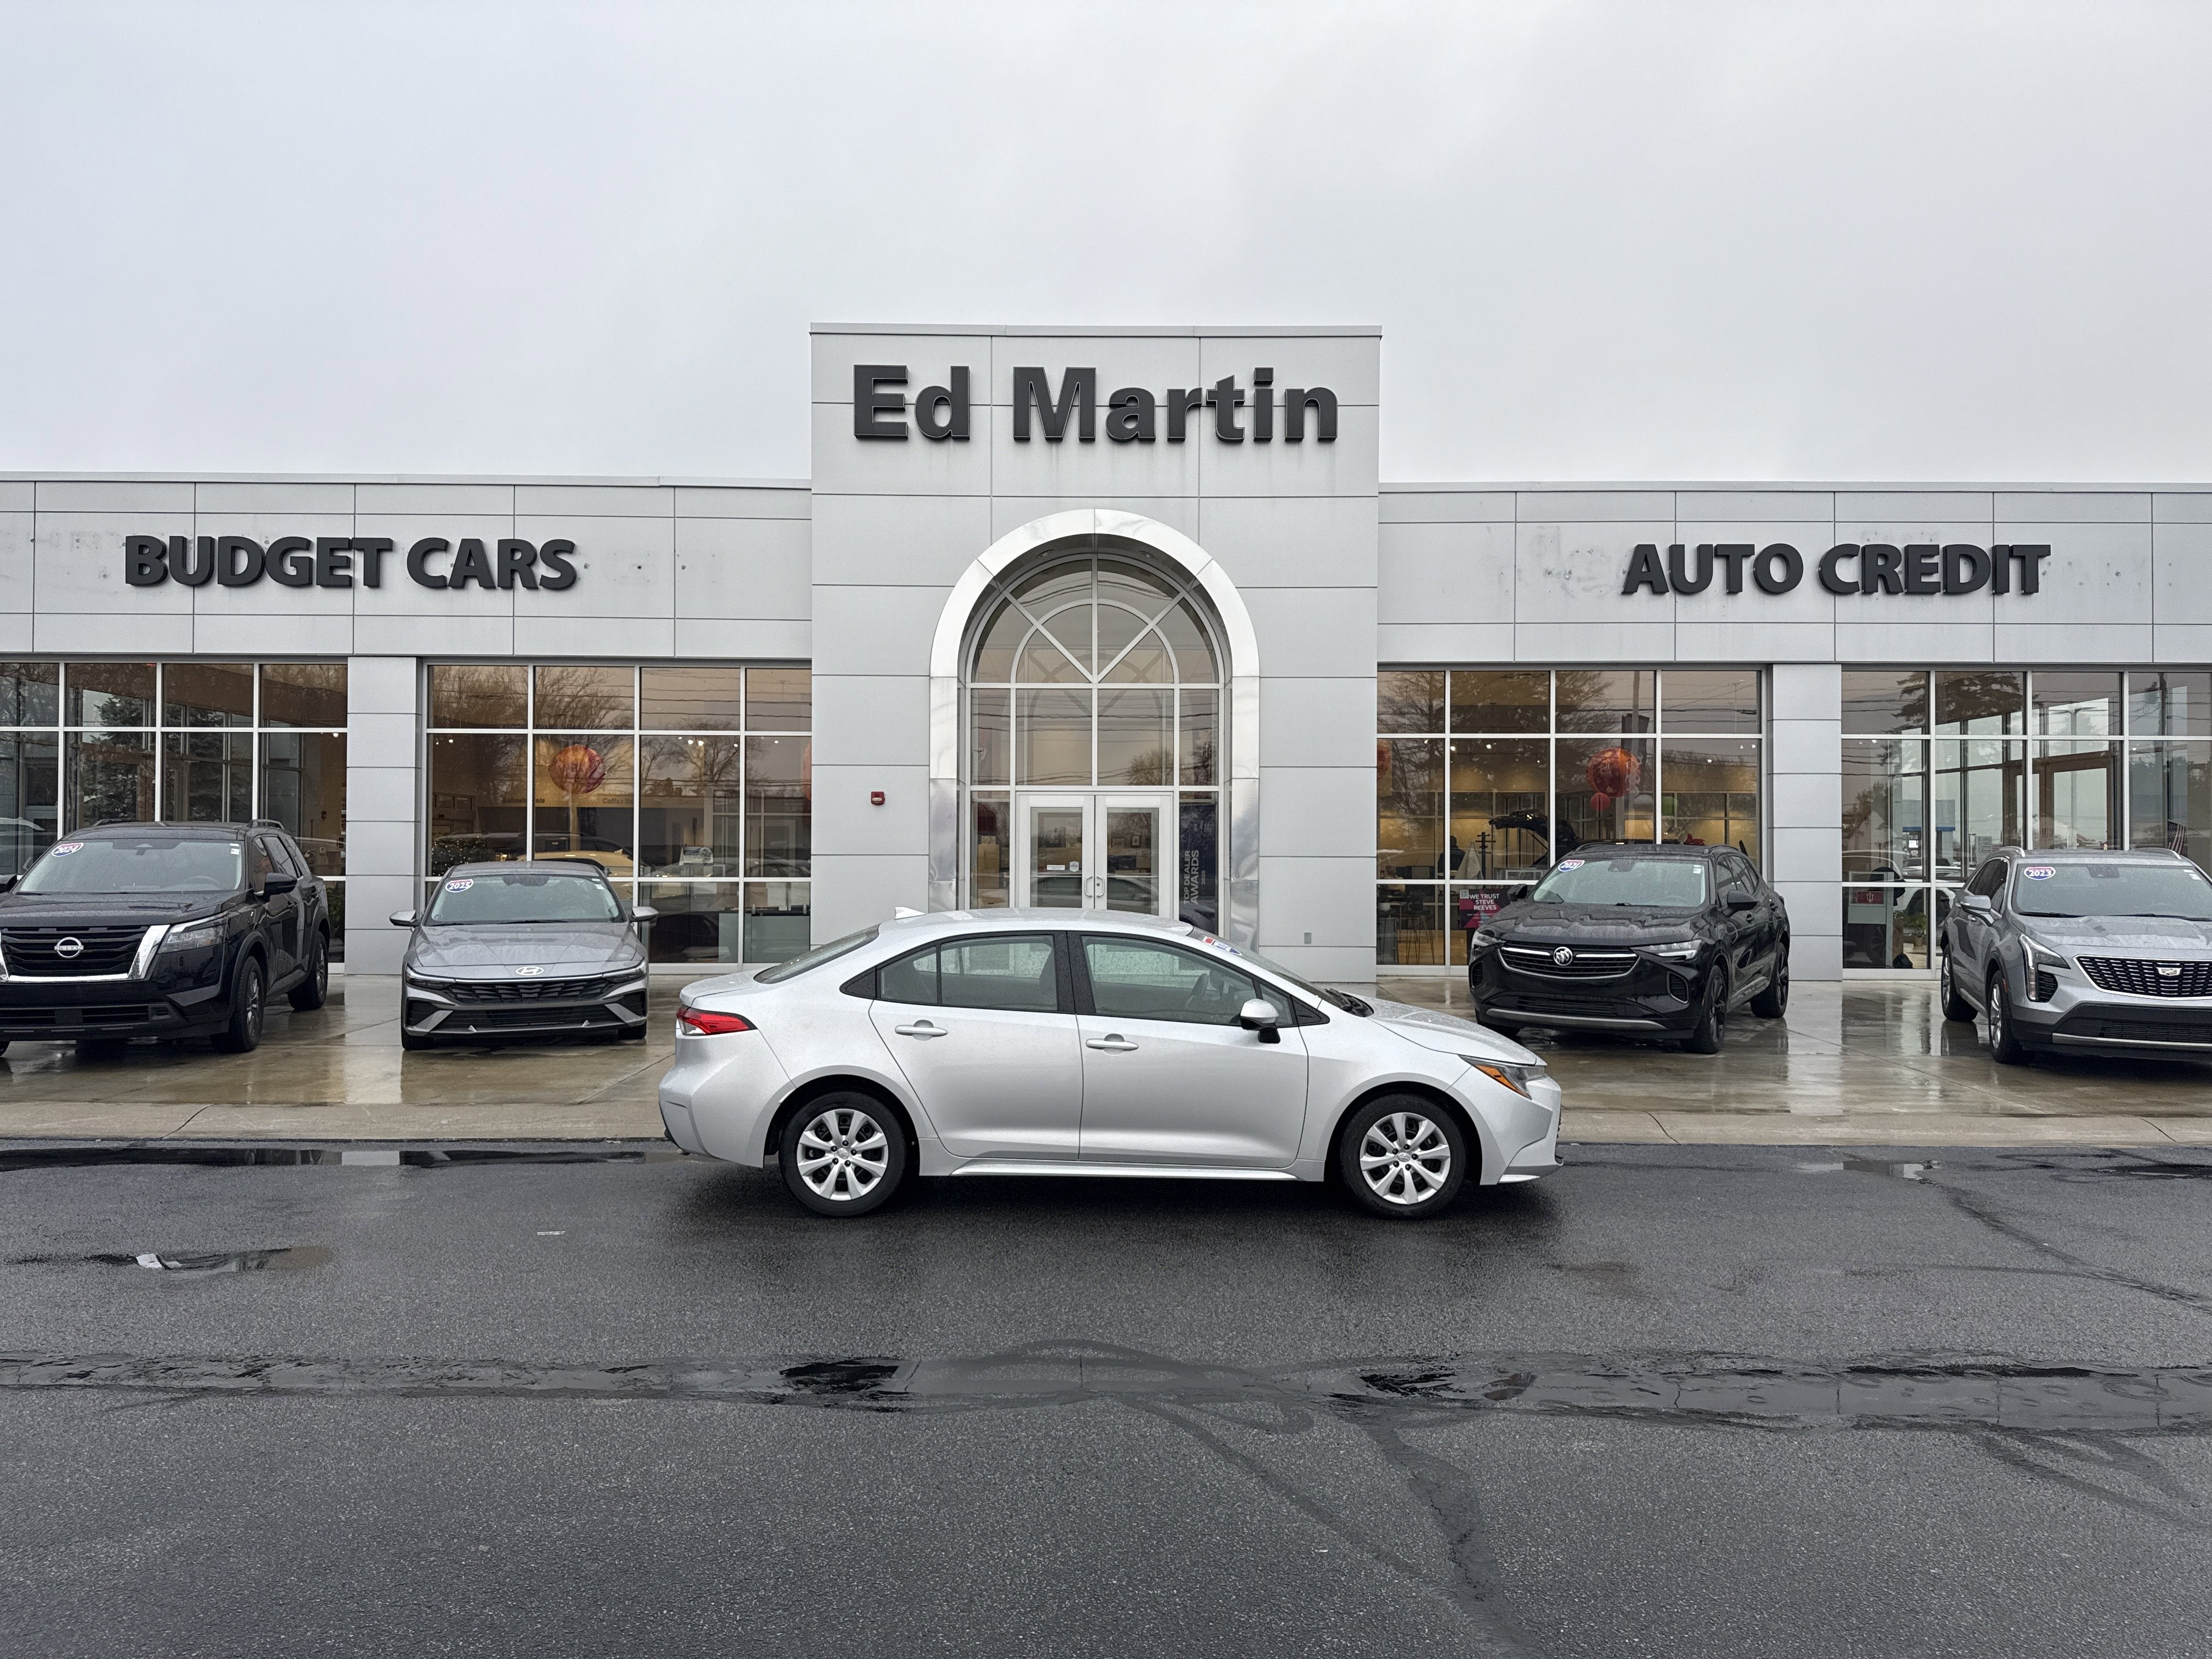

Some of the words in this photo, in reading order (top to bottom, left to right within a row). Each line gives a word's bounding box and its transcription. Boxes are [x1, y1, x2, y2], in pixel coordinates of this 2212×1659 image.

[854, 364, 970, 439] Ed
[1013, 365, 1338, 444] Martin
[125, 535, 393, 589] BUDGET
[407, 537, 577, 590] CARS
[1622, 543, 1804, 595] AUTO
[1818, 543, 2051, 596] CREDIT
[448, 882, 471, 890] 2025
[1190, 849, 1199, 905] AWARDS
